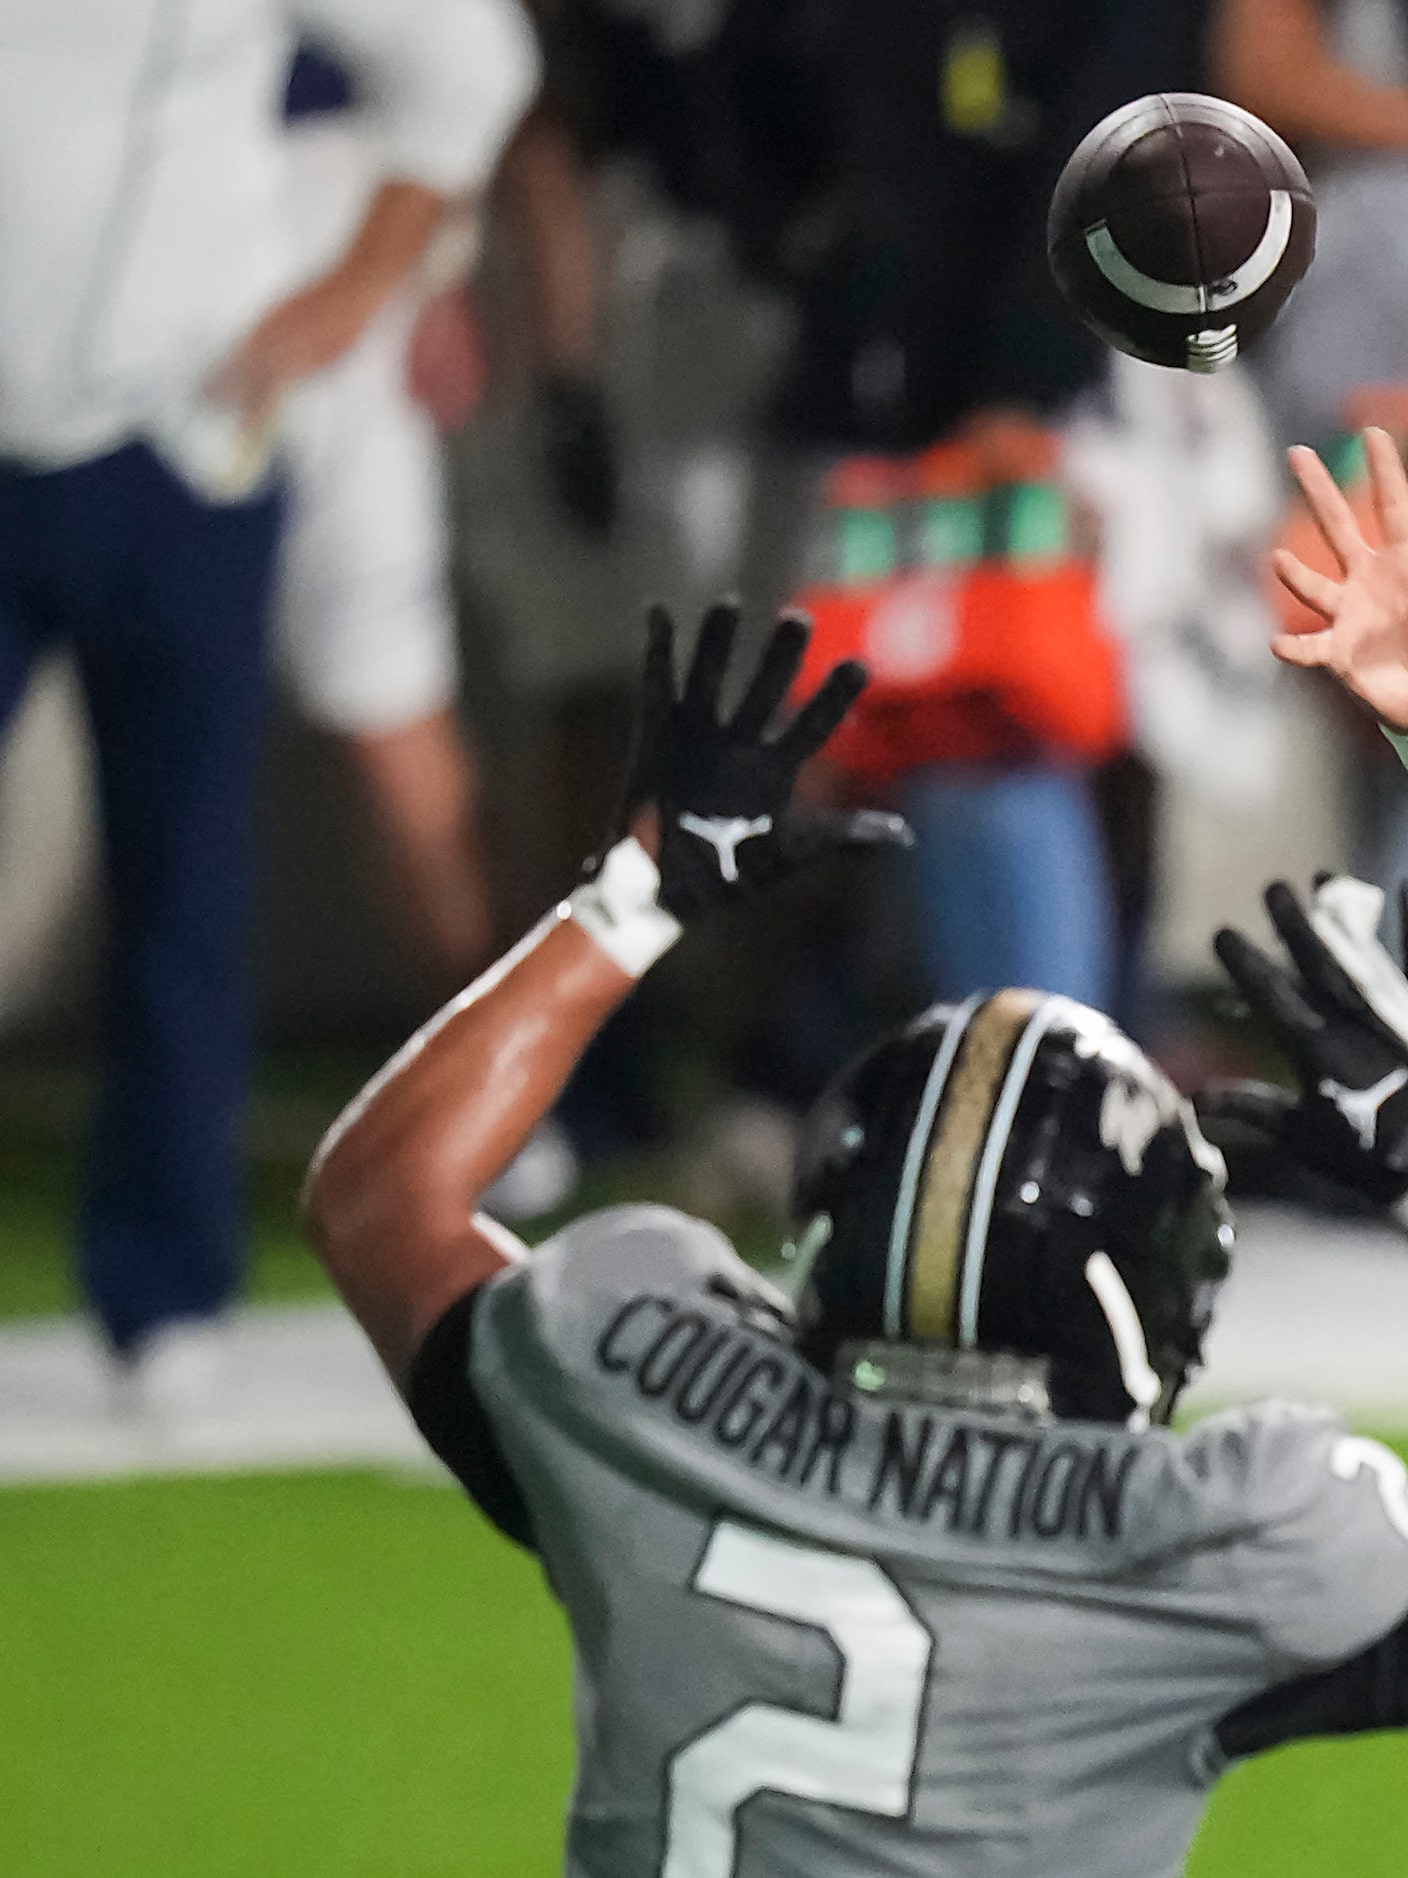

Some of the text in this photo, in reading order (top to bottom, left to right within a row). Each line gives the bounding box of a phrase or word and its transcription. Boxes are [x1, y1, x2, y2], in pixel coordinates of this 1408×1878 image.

[597, 1293, 1142, 1538] COUGAR NATION
[661, 1521, 936, 1878] 2
